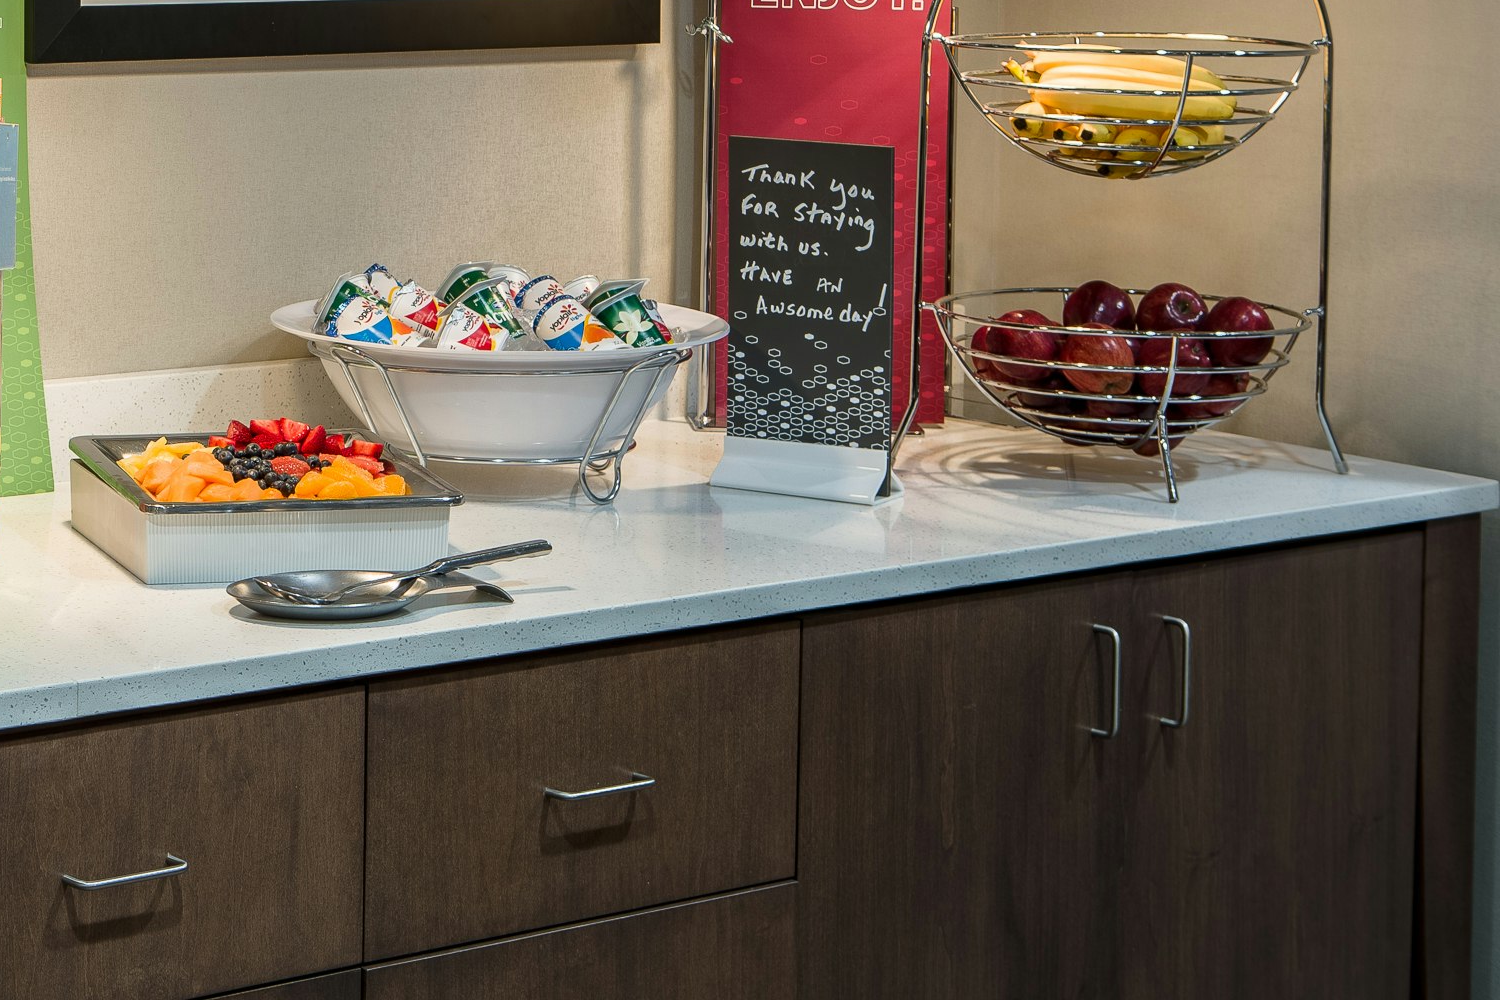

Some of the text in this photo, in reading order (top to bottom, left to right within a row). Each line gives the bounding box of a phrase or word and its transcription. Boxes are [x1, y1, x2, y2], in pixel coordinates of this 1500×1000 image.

[830, 178, 875, 211] you
[740, 231, 788, 252] with
[740, 260, 843, 294] HAVE AN
